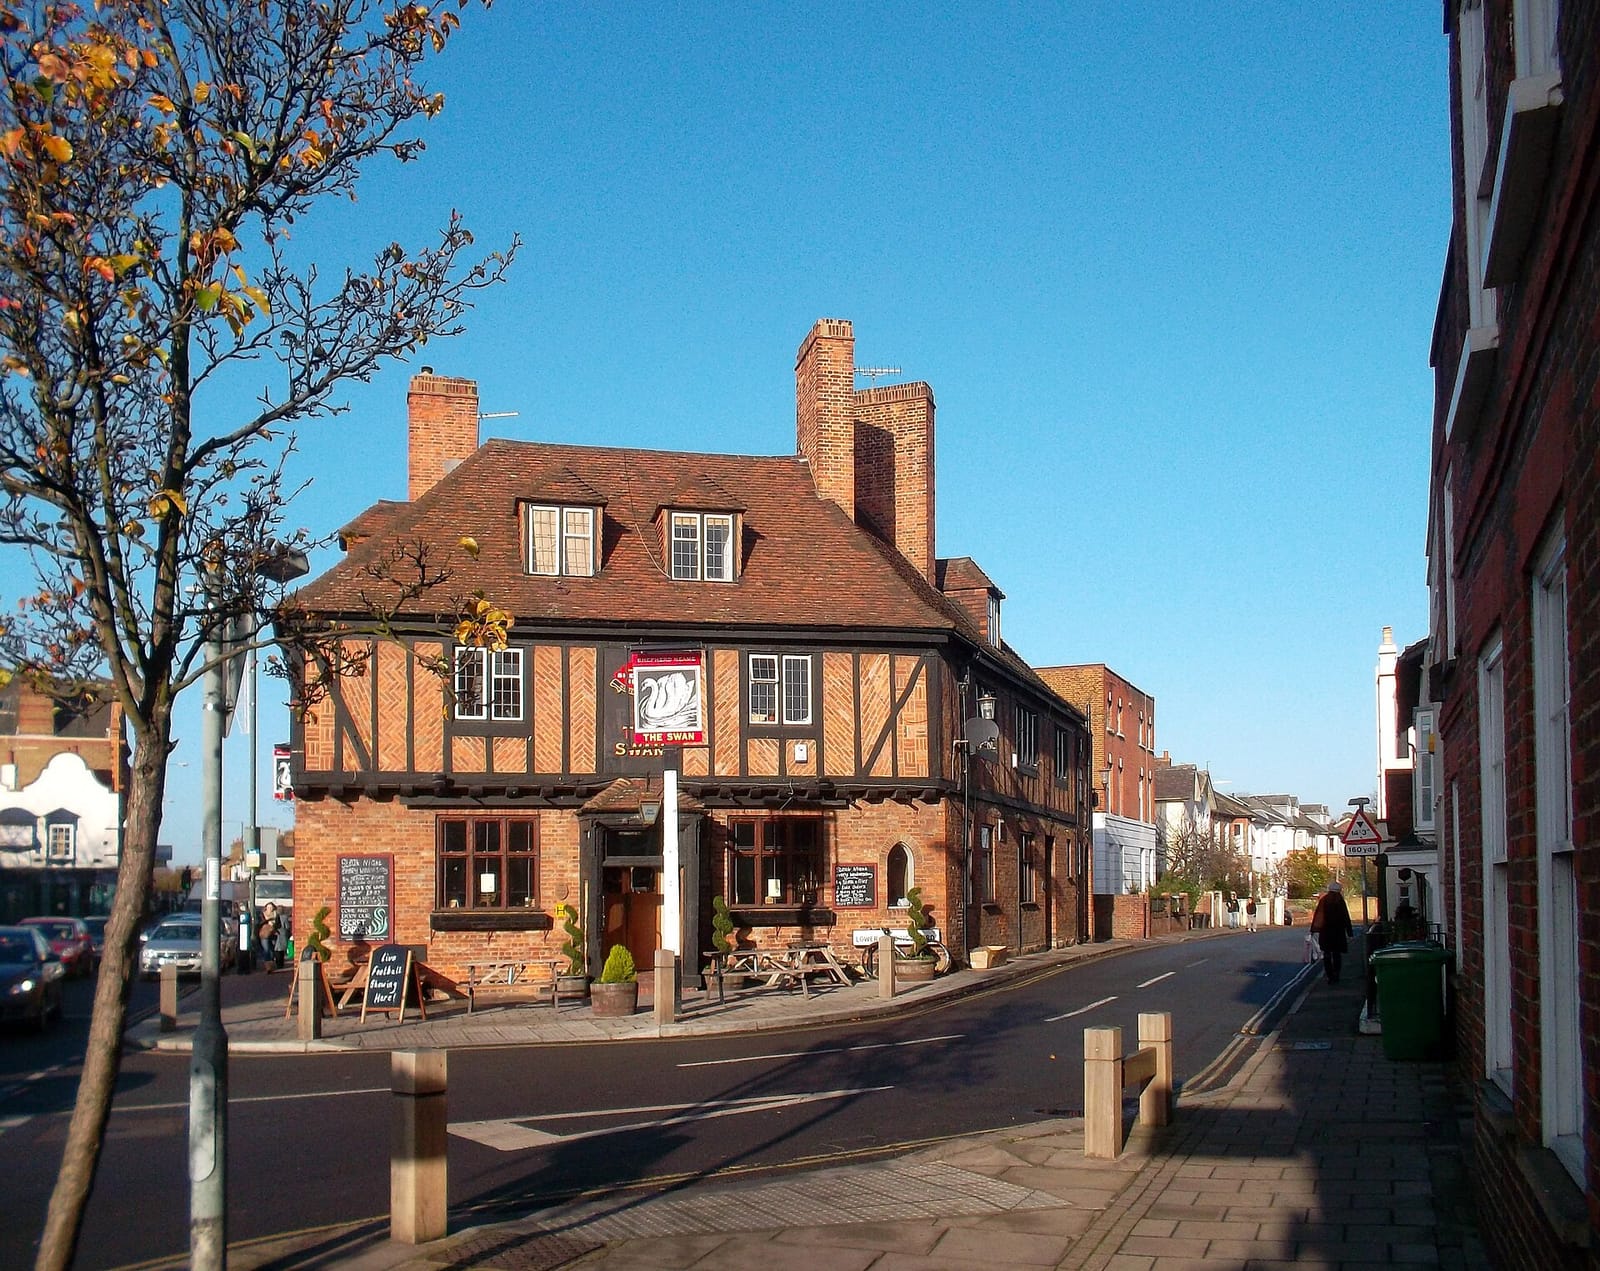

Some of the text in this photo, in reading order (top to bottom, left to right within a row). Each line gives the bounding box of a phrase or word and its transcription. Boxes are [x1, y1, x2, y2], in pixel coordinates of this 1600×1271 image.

[643, 732, 695, 742] THE SWAN
[556, 906, 566, 915] H
[340, 919, 366, 927] SECRET
[856, 935, 878, 943] LOWER
[380, 952, 397, 963] Live
